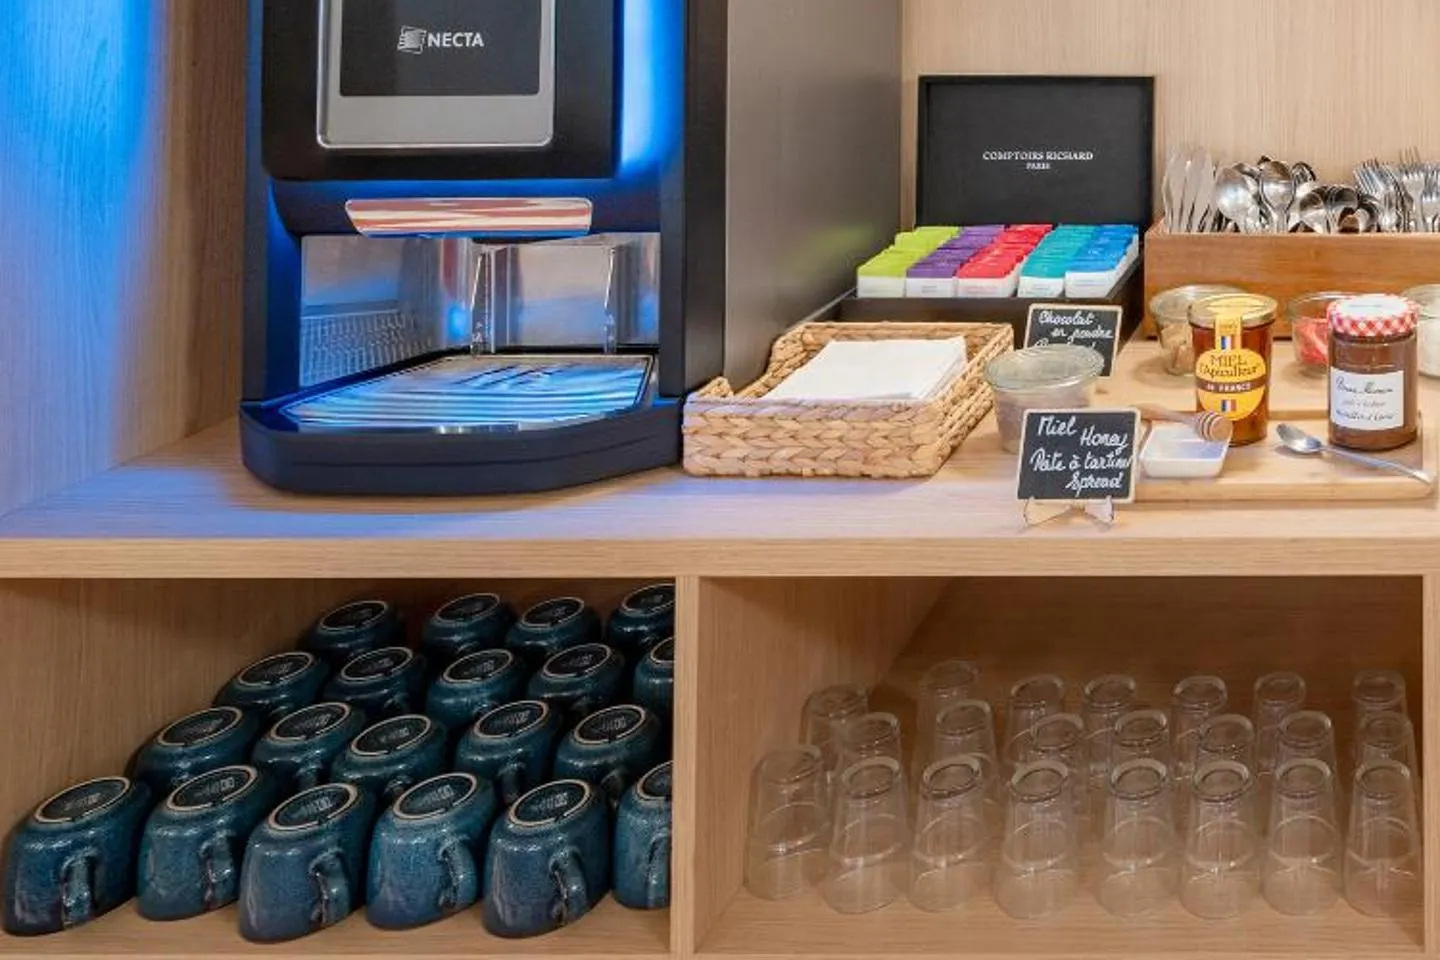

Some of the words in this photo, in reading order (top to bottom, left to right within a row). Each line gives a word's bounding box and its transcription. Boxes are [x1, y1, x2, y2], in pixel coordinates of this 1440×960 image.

[427, 32, 485, 47] NECTA
[982, 150, 1044, 161] COMPTOIRS
[1045, 150, 1094, 161] RICHARD
[1026, 161, 1051, 170] PARIS
[1038, 310, 1095, 325] Chocolat
[1037, 415, 1077, 436] Miel
[1080, 424, 1129, 456] Honey
[1065, 471, 1124, 497] Spread
